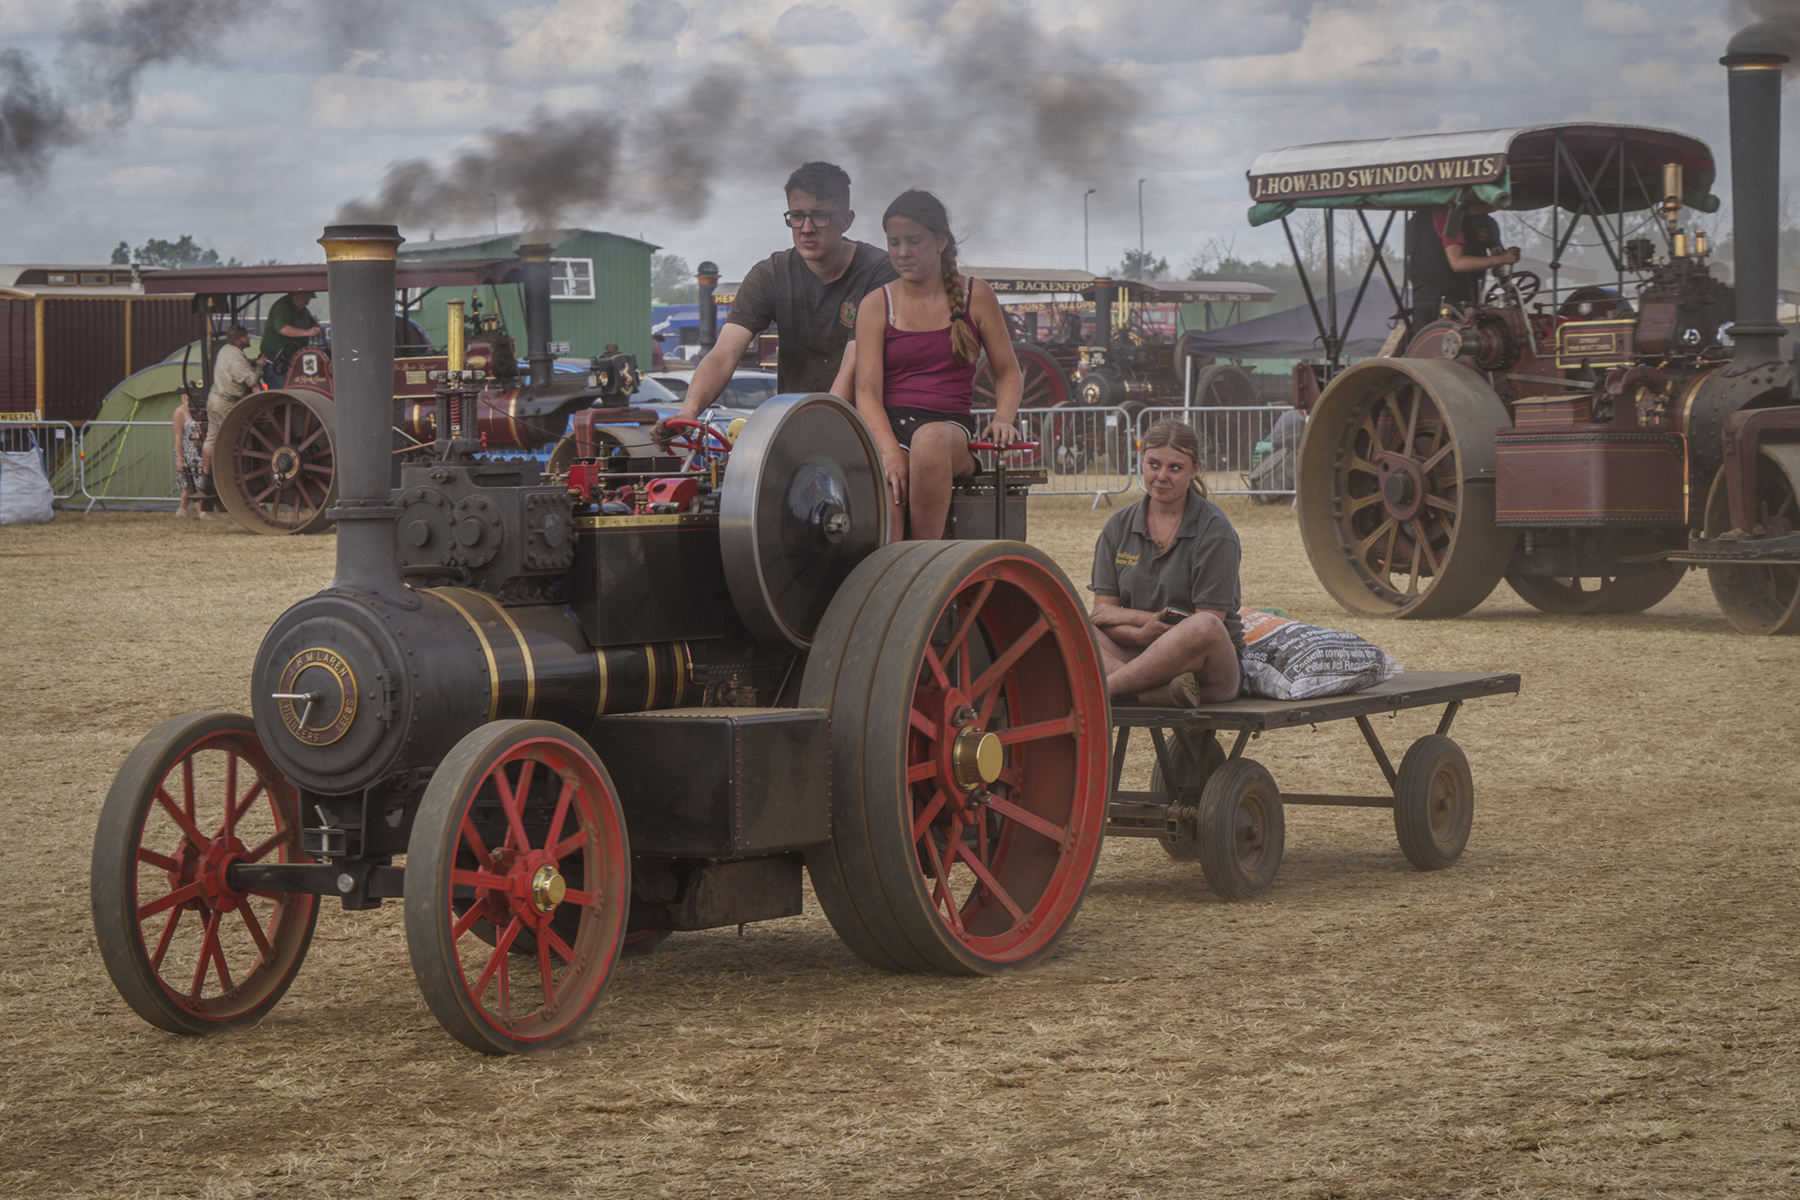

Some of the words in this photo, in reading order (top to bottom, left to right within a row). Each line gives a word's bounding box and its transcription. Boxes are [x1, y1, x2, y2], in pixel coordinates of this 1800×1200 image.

[1347, 162, 1436, 189] SWINDON
[1436, 157, 1499, 180] WILTS.
[1015, 281, 1096, 292] RACKENFOR
[1018, 302, 1046, 311] SONS
[1293, 648, 1324, 673] Contents
[1325, 647, 1350, 660] comply
[1364, 648, 1377, 658] the
[335, 699, 355, 733] LEEDS
